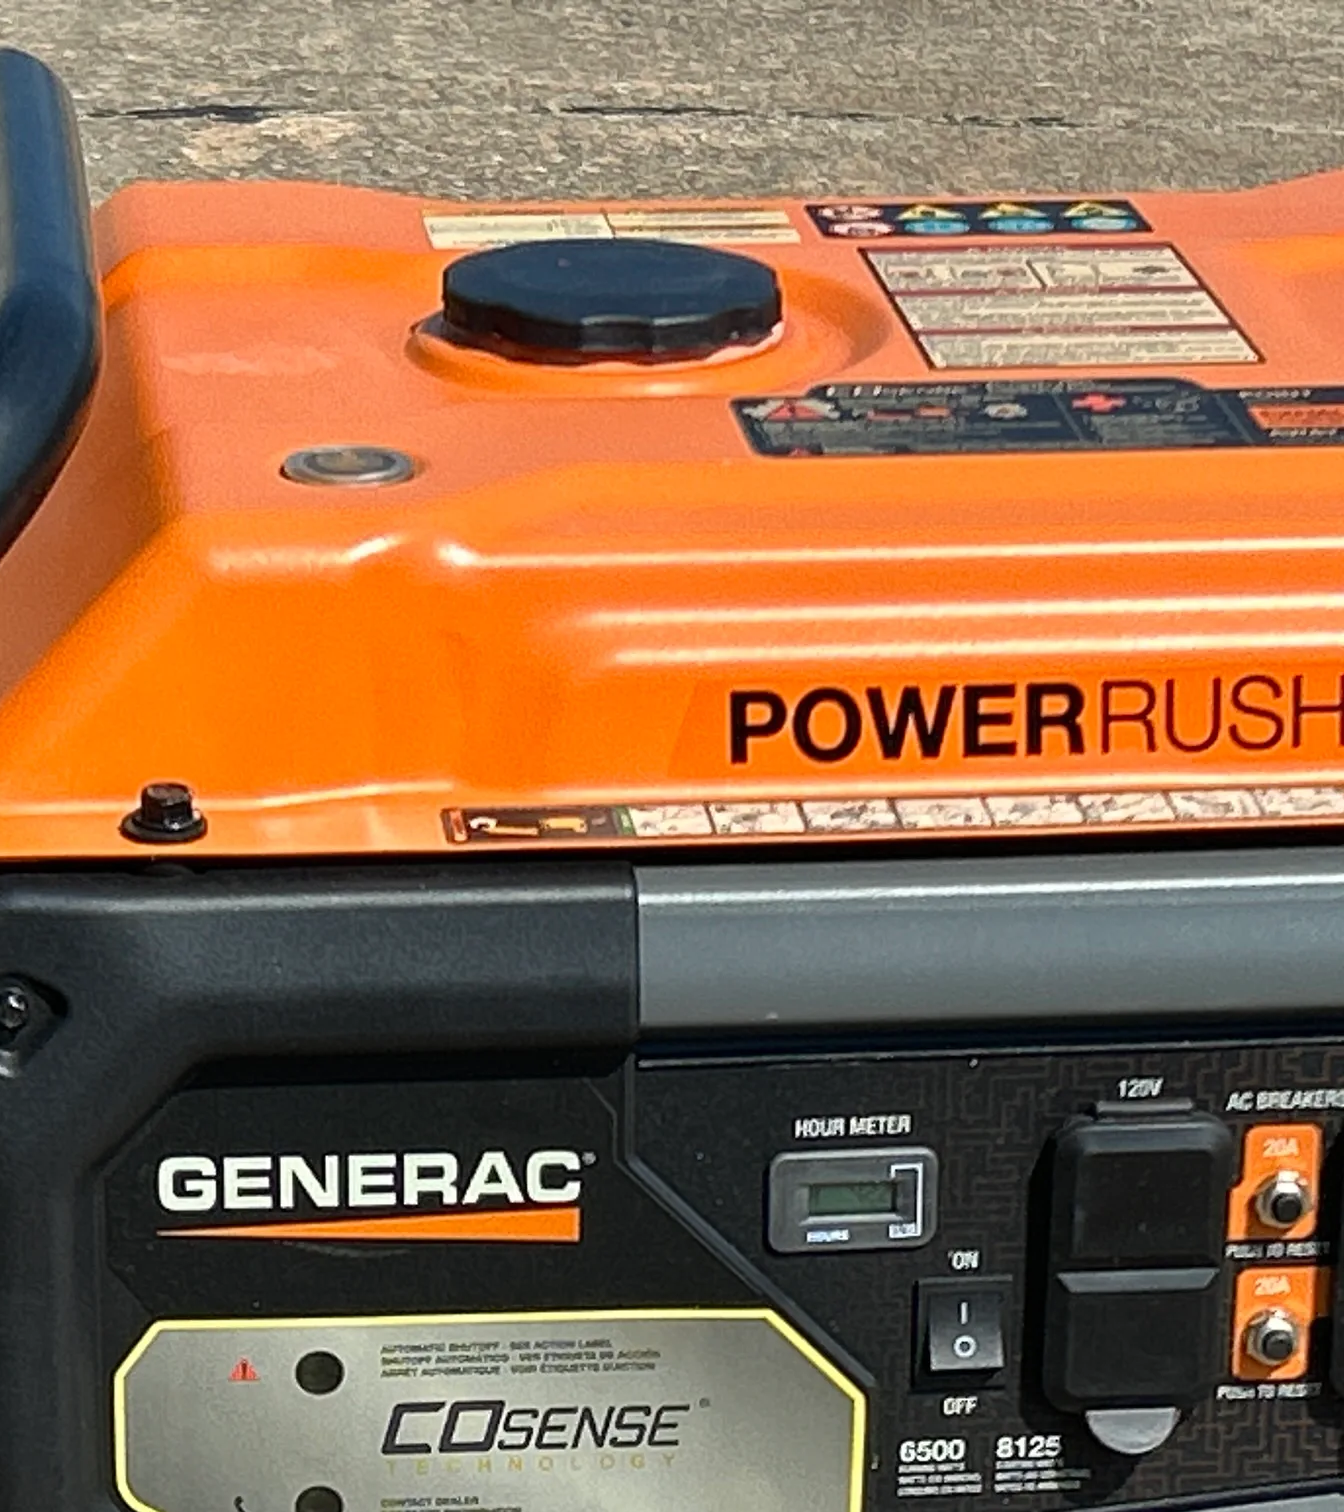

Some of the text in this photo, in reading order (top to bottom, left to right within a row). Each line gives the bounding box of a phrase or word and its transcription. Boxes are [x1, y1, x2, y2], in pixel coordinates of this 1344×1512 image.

[1118, 1076, 1164, 1098] 120V
[1225, 1090, 1253, 1111] AC
[794, 1114, 911, 1138] HOUR METER
[1262, 1138, 1300, 1158] 20A
[157, 1150, 582, 1212] GENERAC
[950, 1250, 980, 1270] ON
[1254, 1274, 1292, 1296] 20A
[942, 1396, 978, 1416] OFF
[898, 1434, 1062, 1463] 6500 8125
[384, 1452, 678, 1477] TECHNOLOGY
